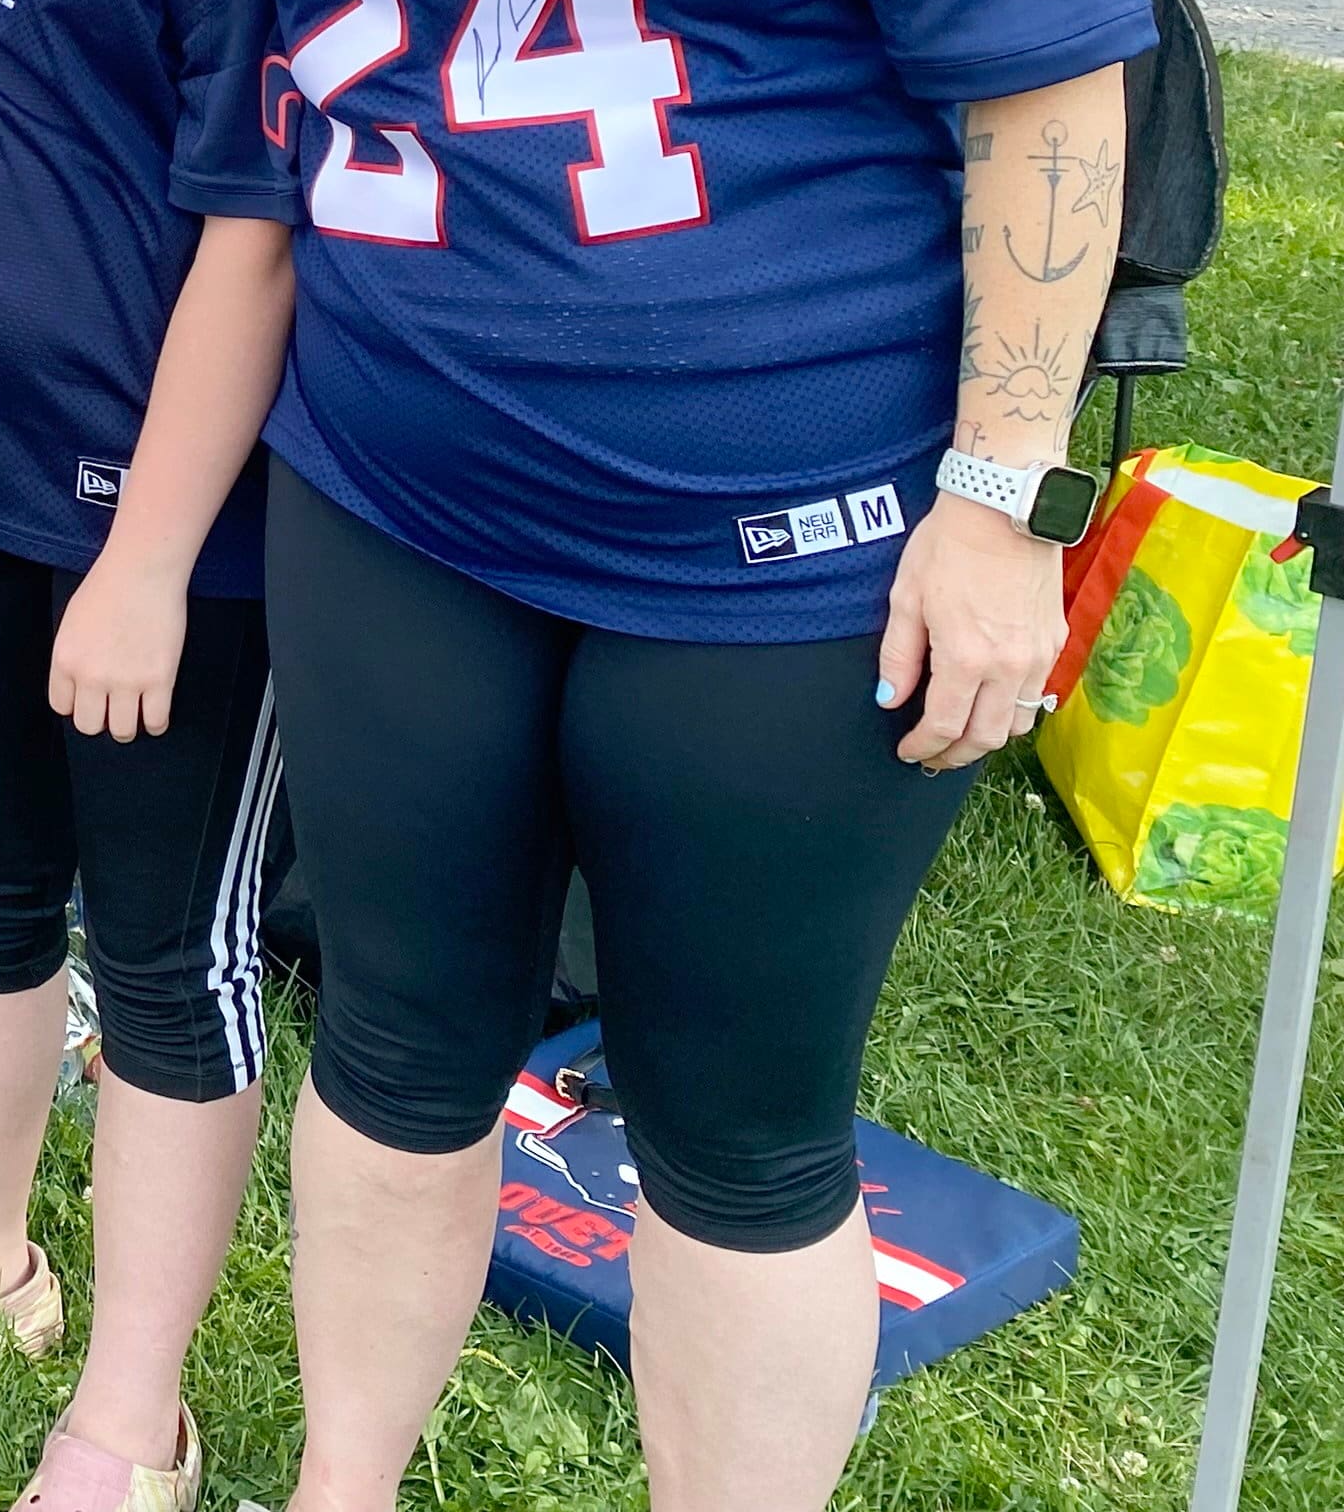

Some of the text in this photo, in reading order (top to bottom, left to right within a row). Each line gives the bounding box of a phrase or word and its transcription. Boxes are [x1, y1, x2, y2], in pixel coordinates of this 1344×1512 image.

[799, 511, 834, 529] NEW
[860, 495, 892, 530] M
[802, 526, 838, 543] ERA
